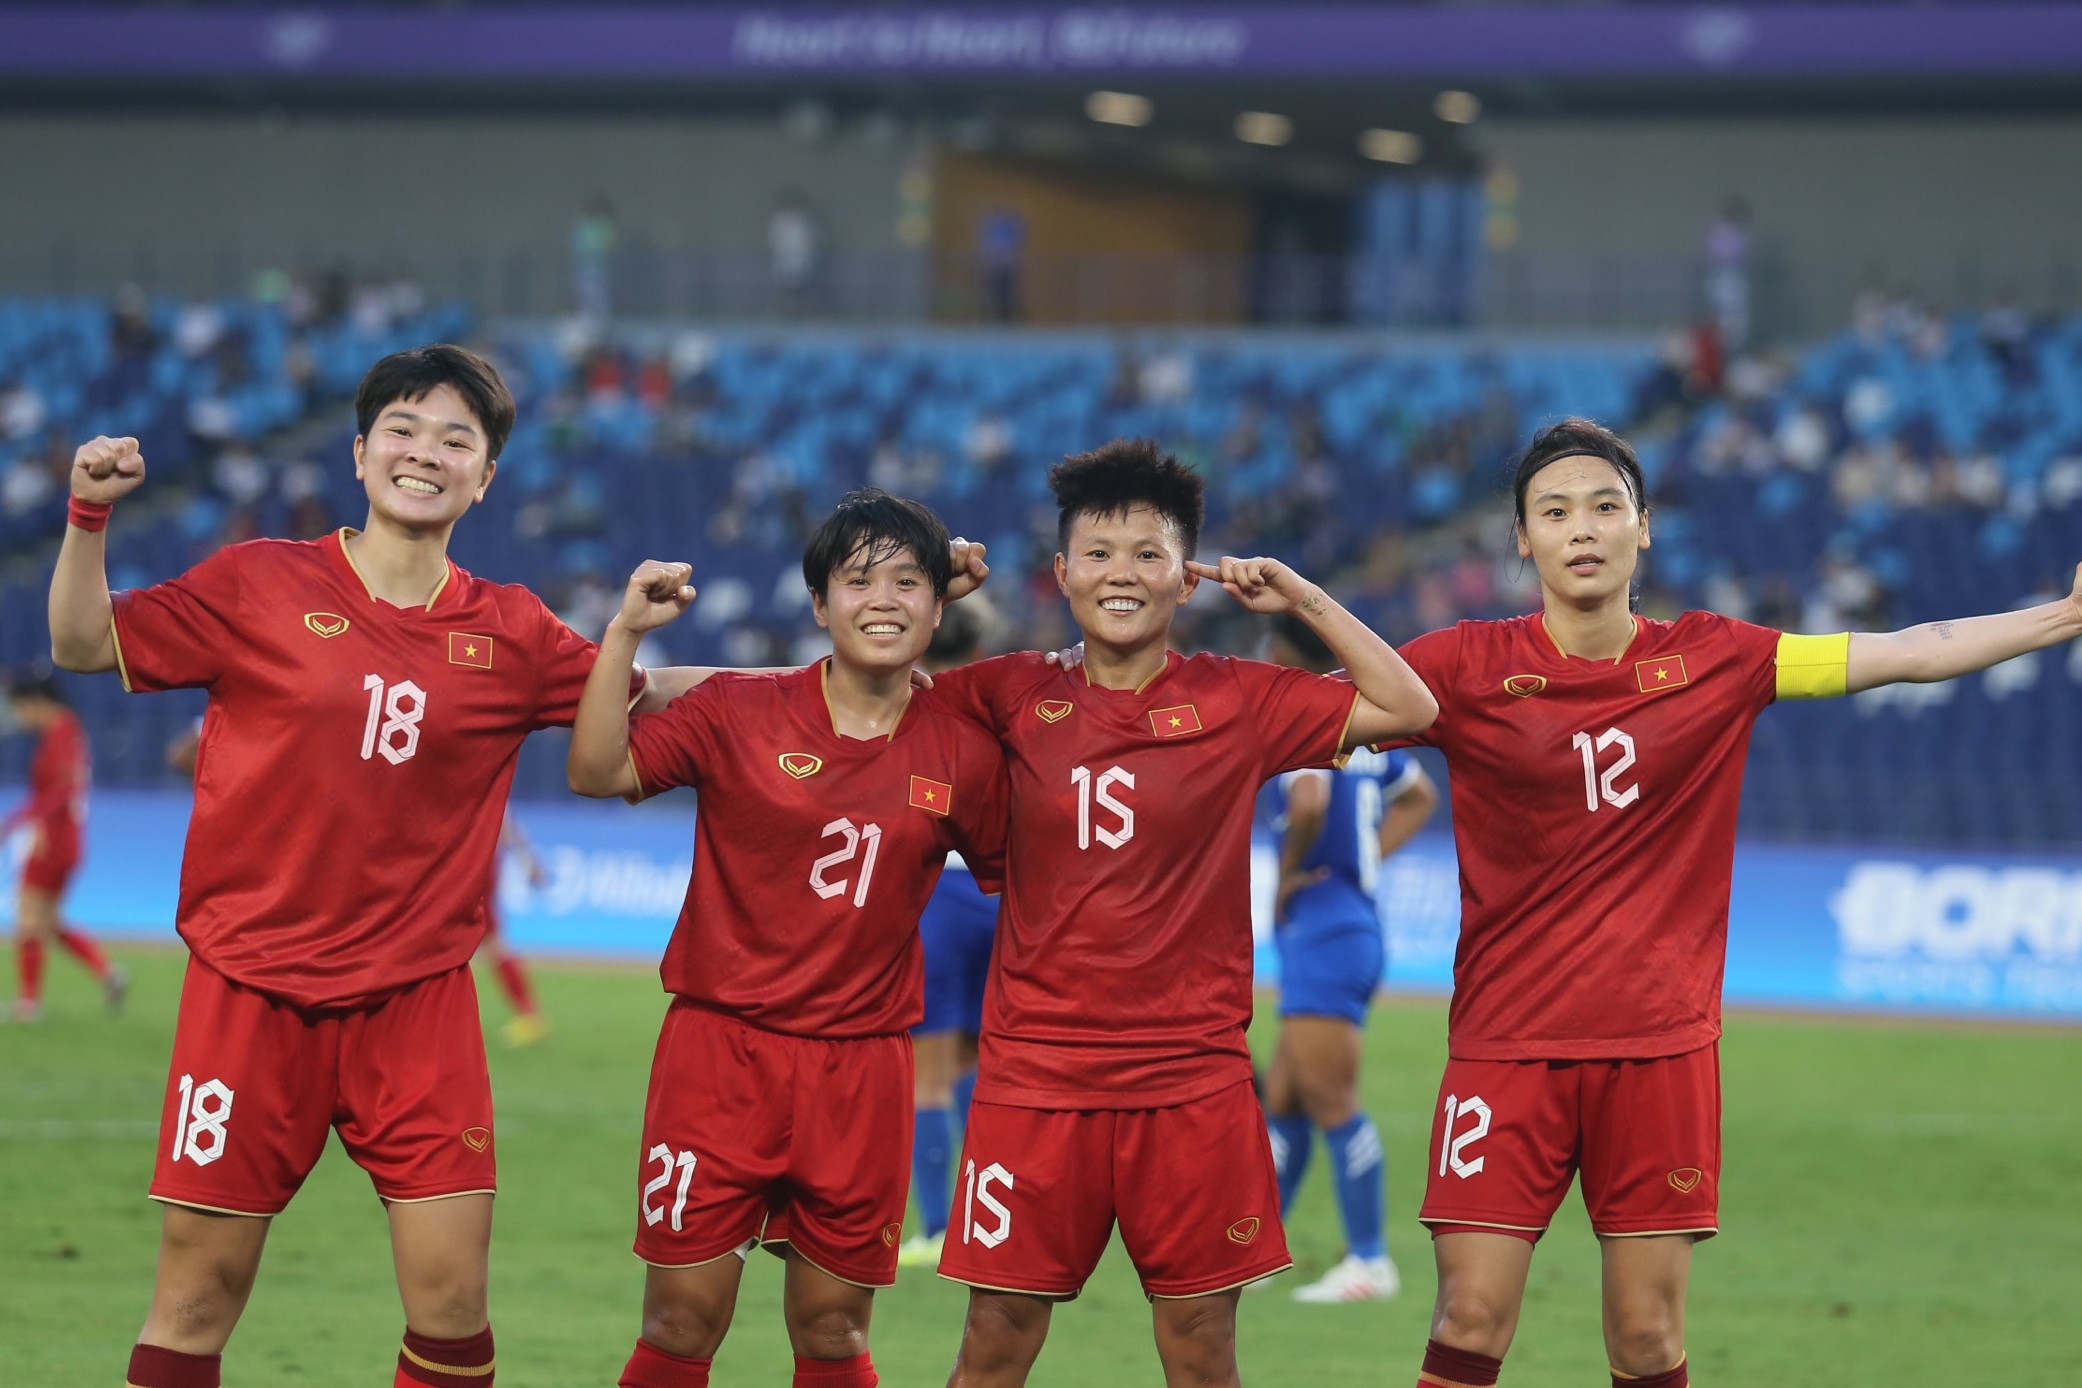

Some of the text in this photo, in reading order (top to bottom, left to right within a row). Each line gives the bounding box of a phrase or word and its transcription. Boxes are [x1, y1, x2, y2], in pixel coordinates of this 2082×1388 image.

[360, 673, 427, 766] 18
[1572, 726, 1640, 813] 12
[808, 816, 883, 908] 21
[171, 1073, 235, 1167] 18
[1439, 1093, 1492, 1180] 12
[642, 1142, 698, 1232] 21
